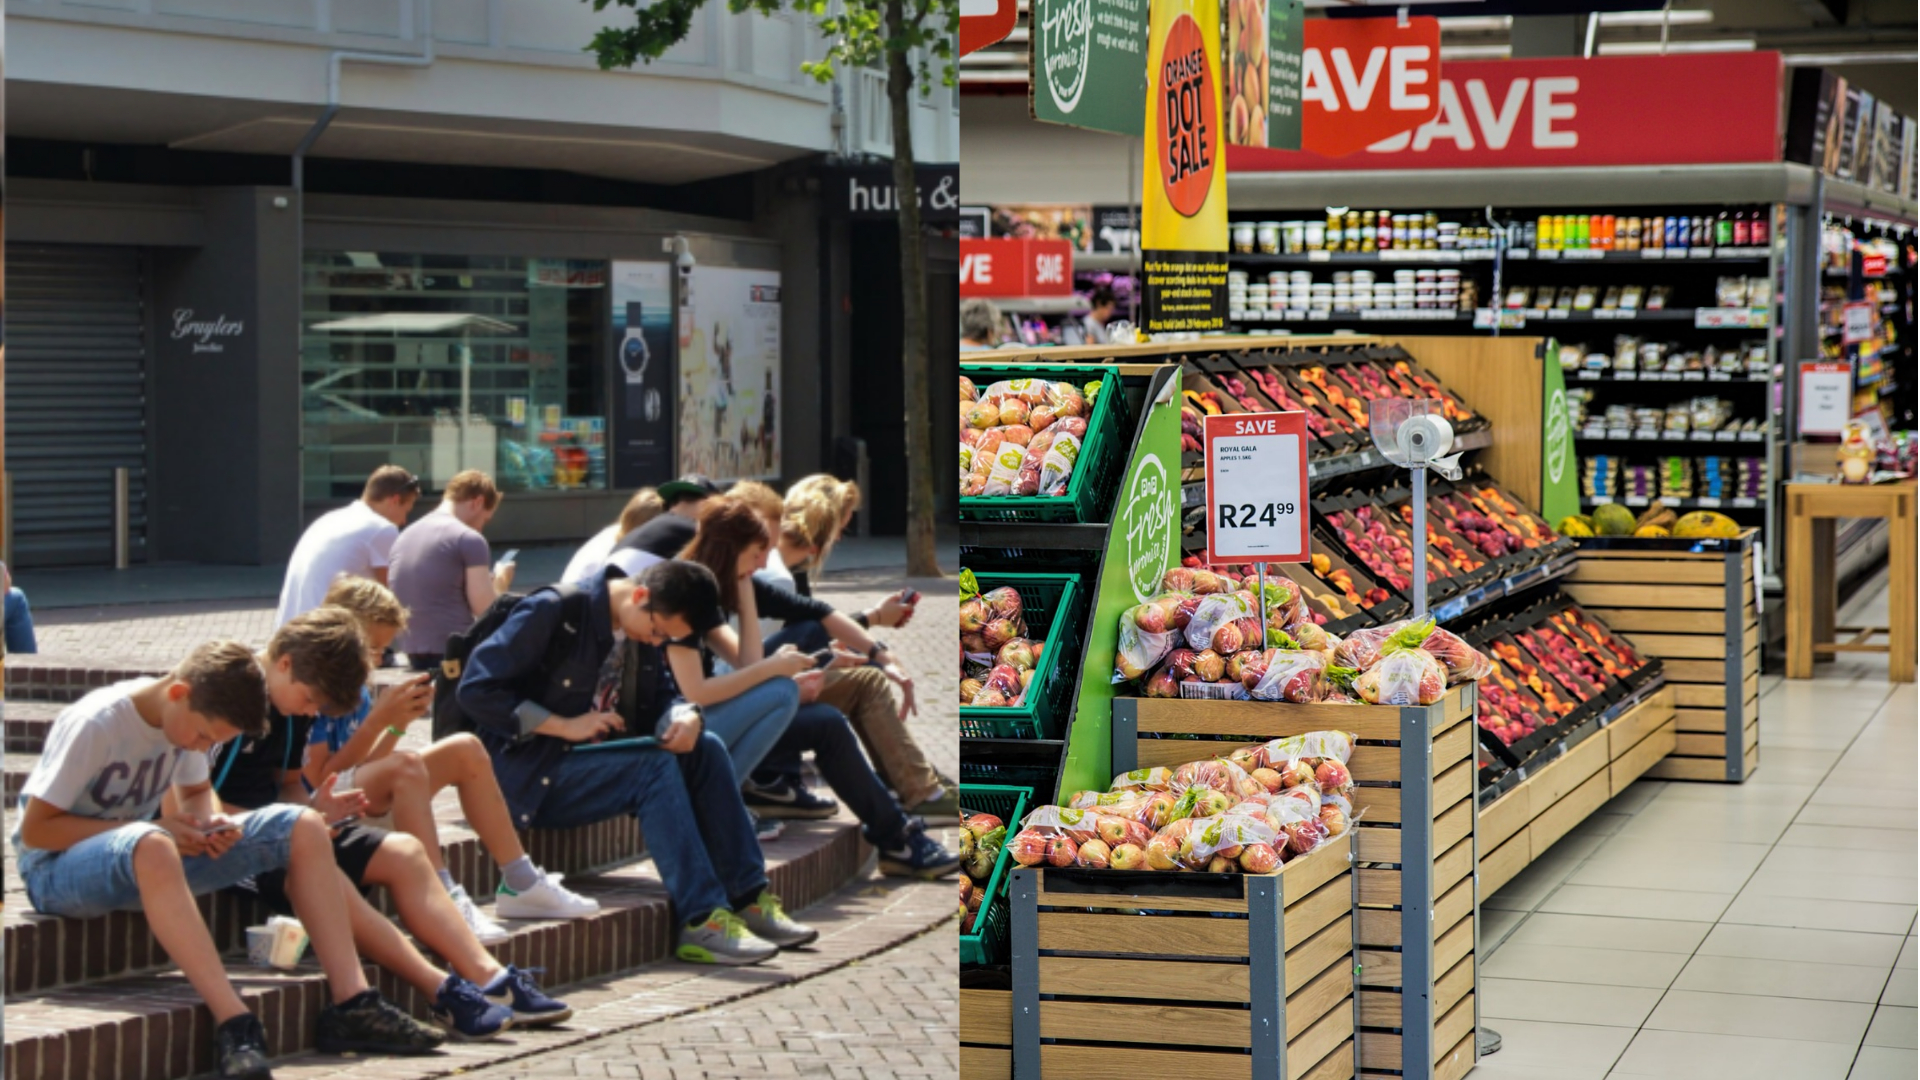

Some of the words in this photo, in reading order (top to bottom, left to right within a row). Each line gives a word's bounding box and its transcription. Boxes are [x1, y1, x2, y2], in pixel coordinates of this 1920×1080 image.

[1165, 48, 1203, 88] ORANGE
[1302, 46, 1430, 112] AVE
[1166, 75, 1203, 140] DOT
[1366, 76, 1580, 152] AVE
[1168, 125, 1210, 186] SALE
[929, 175, 959, 210] &
[959, 253, 993, 284] VE
[1036, 253, 1063, 284] SAVE
[1235, 420, 1276, 435] SAVE
[1123, 468, 1175, 551] Fresh
[1133, 542, 1160, 588] promise
